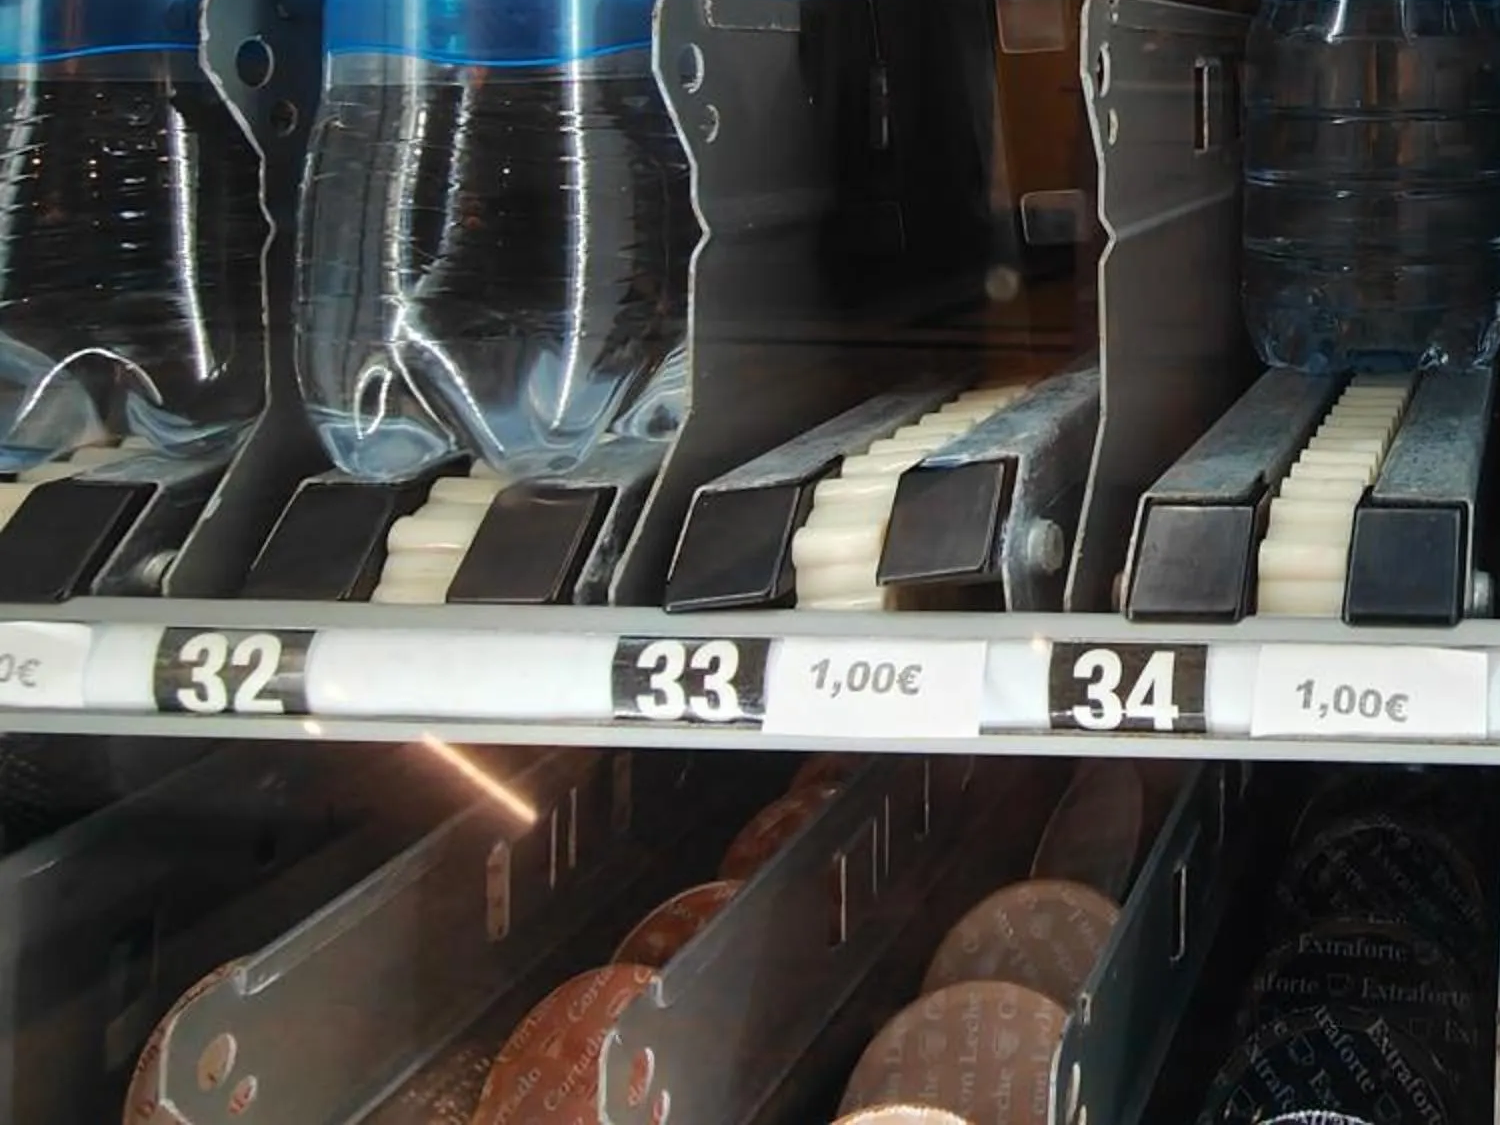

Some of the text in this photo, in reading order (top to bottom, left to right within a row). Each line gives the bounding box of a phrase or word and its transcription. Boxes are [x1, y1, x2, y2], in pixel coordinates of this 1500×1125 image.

[0, 653, 43, 688] 0€
[176, 633, 285, 714] 32
[635, 641, 738, 722] 33
[809, 658, 923, 700] 1,00€
[1073, 648, 1179, 731] 34
[1295, 679, 1410, 724] 1,00€
[1314, 1005, 1376, 1095] traforte
[1366, 1016, 1443, 1125] Extrafort
